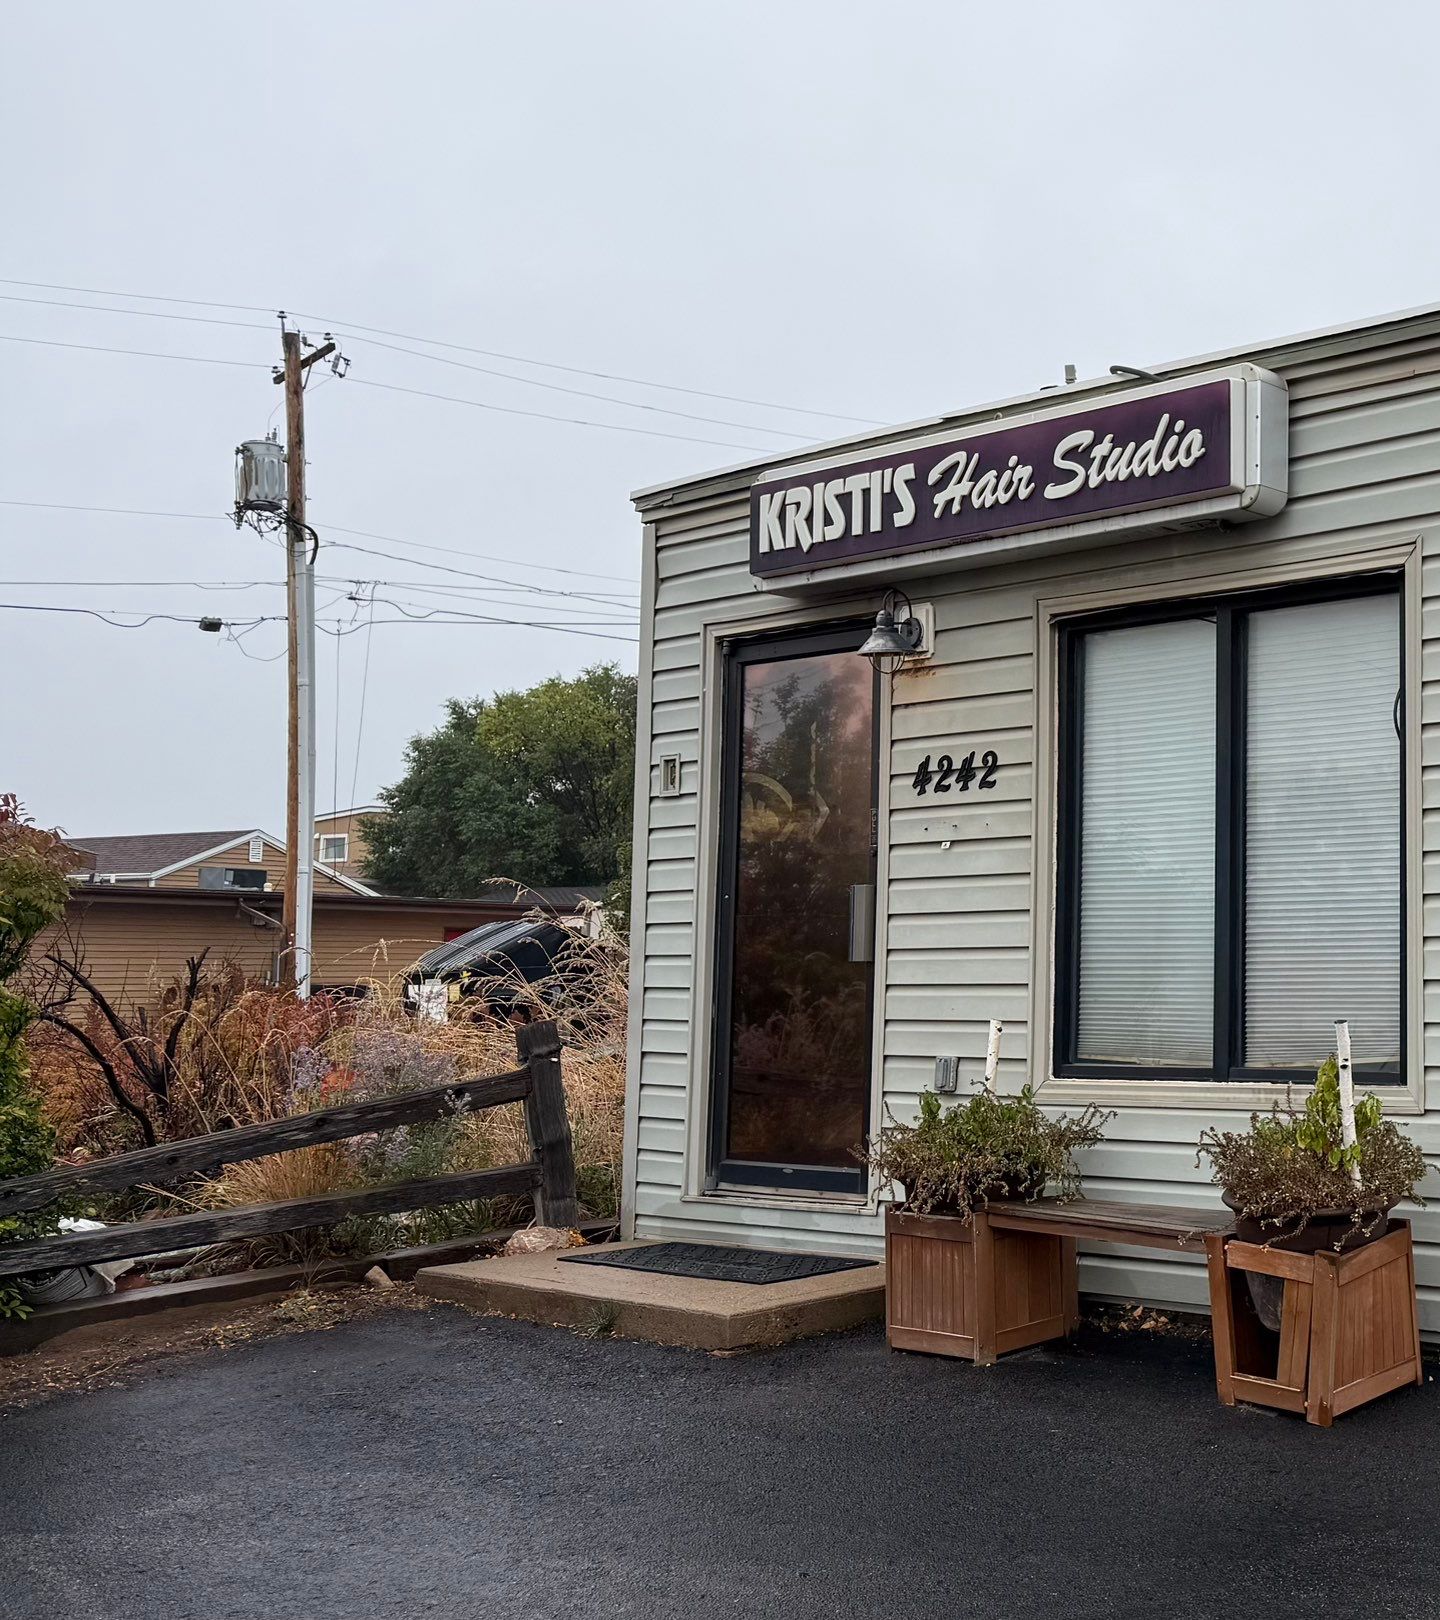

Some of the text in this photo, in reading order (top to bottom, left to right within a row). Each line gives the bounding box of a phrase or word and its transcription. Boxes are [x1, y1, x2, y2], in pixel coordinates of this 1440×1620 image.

[759, 413, 1206, 553] KRISTI'S Hair Studio
[912, 750, 998, 796] 4242
